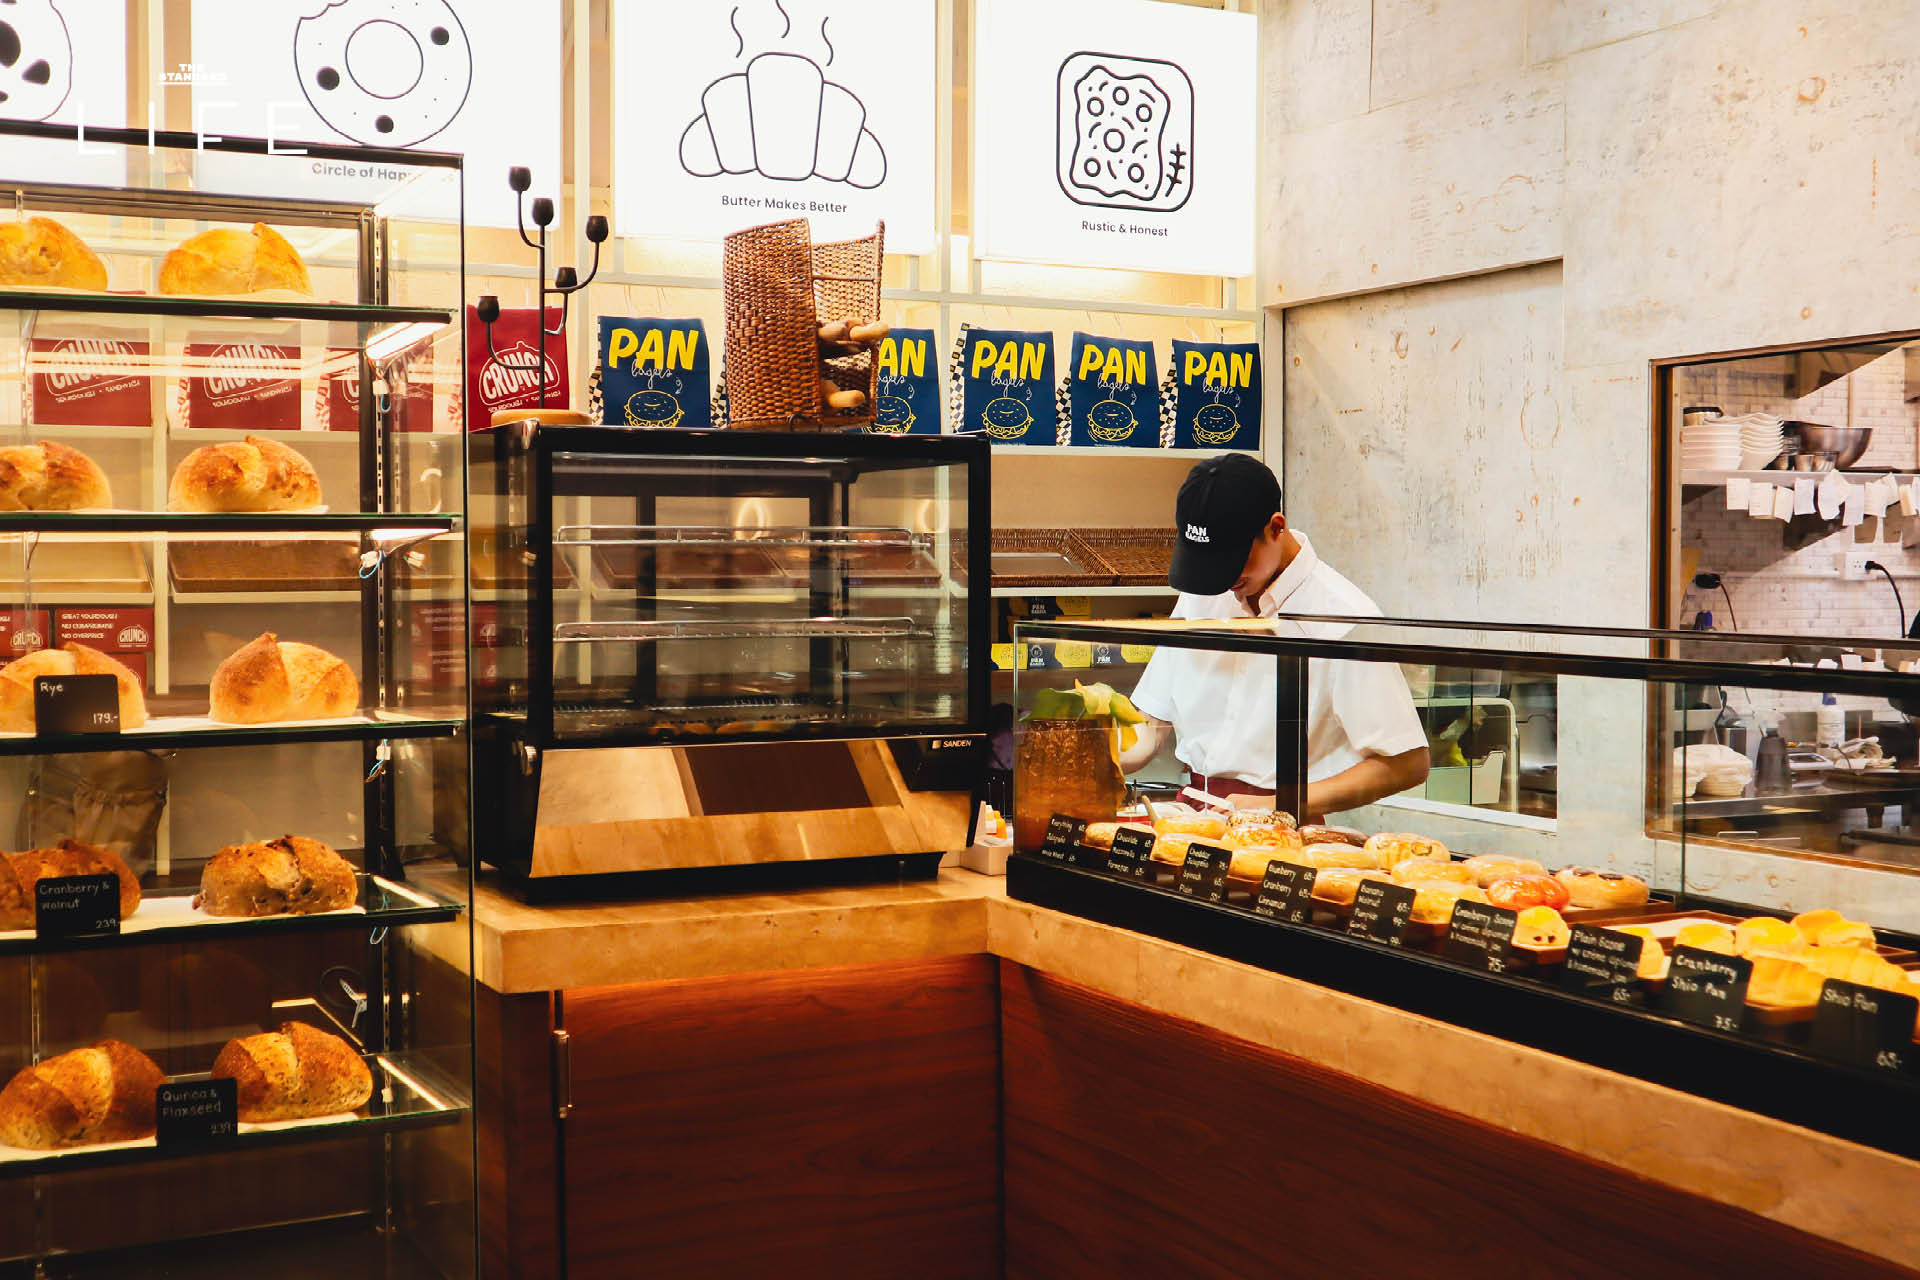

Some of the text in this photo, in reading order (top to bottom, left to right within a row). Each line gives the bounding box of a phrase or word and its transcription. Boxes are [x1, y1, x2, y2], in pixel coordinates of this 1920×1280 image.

[311, 162, 356, 177] Circle
[359, 166, 374, 178] of
[721, 195, 847, 213] Butter Makes Better
[1082, 220, 1168, 237] Rustic & Honest
[608, 327, 699, 371] PAN
[878, 337, 926, 377] AN
[971, 339, 1046, 381] PAN
[482, 351, 555, 400] CRUNCH
[1078, 343, 1147, 386] PAN
[1184, 350, 1253, 388] PAN
[877, 375, 906, 397] agels
[1187, 523, 1207, 537] PAN
[119, 629, 148, 643] CRUNCH
[40, 682, 64, 696] Rye
[943, 740, 972, 748] SANDEN
[39, 883, 99, 896] Cranberry
[1675, 954, 1737, 984] Cranberry
[1671, 976, 1727, 1001] Shio Pan
[1823, 987, 1879, 1015] Shio Pan
